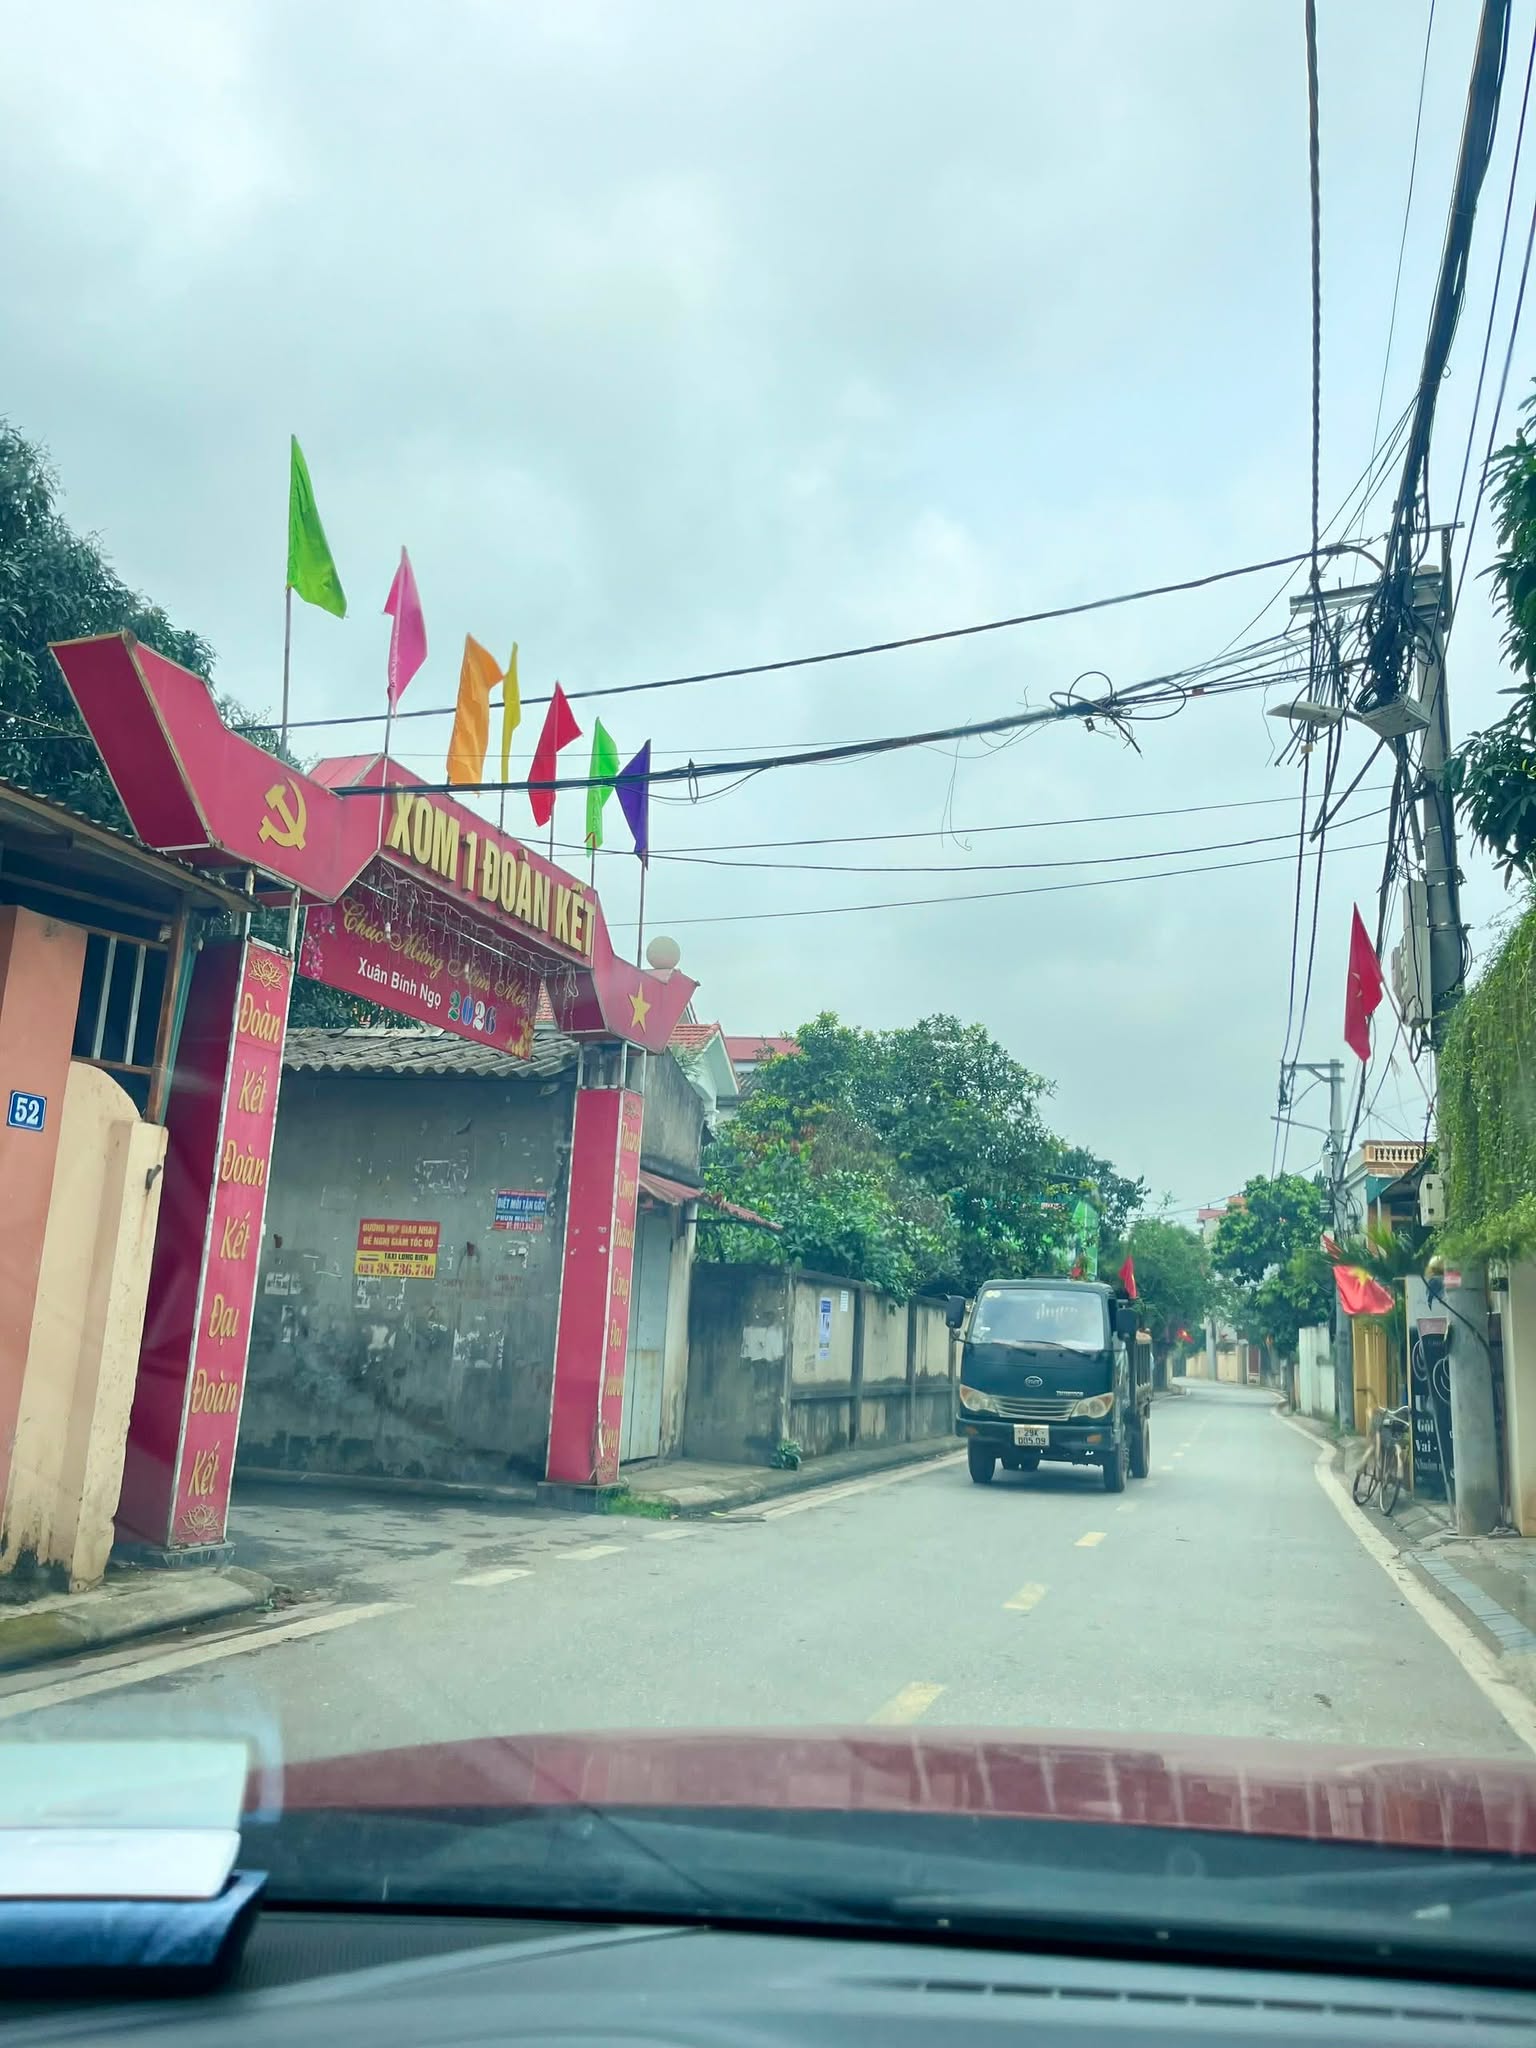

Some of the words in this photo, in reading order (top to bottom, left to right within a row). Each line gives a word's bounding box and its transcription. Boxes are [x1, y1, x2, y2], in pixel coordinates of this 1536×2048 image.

[463, 831, 478, 892] 1
[479, 839, 551, 932] ĐOÀN
[357, 957, 388, 985] Xuân
[391, 971, 417, 997] Bính
[420, 983, 442, 1009] Ngọ
[239, 992, 281, 1043] Đoàn
[448, 990, 497, 1035] 2026
[15, 1096, 40, 1125] 52
[239, 1067, 267, 1114] Kết
[221, 1139, 265, 1187] Đoàn
[220, 1210, 250, 1260] Kết
[385, 1252, 397, 1260] TAXI
[208, 1293, 239, 1346] Đại
[190, 1368, 238, 1415] Đoàn
[188, 1441, 220, 1497] Kết
[1415, 1439, 1431, 1454] Vai
